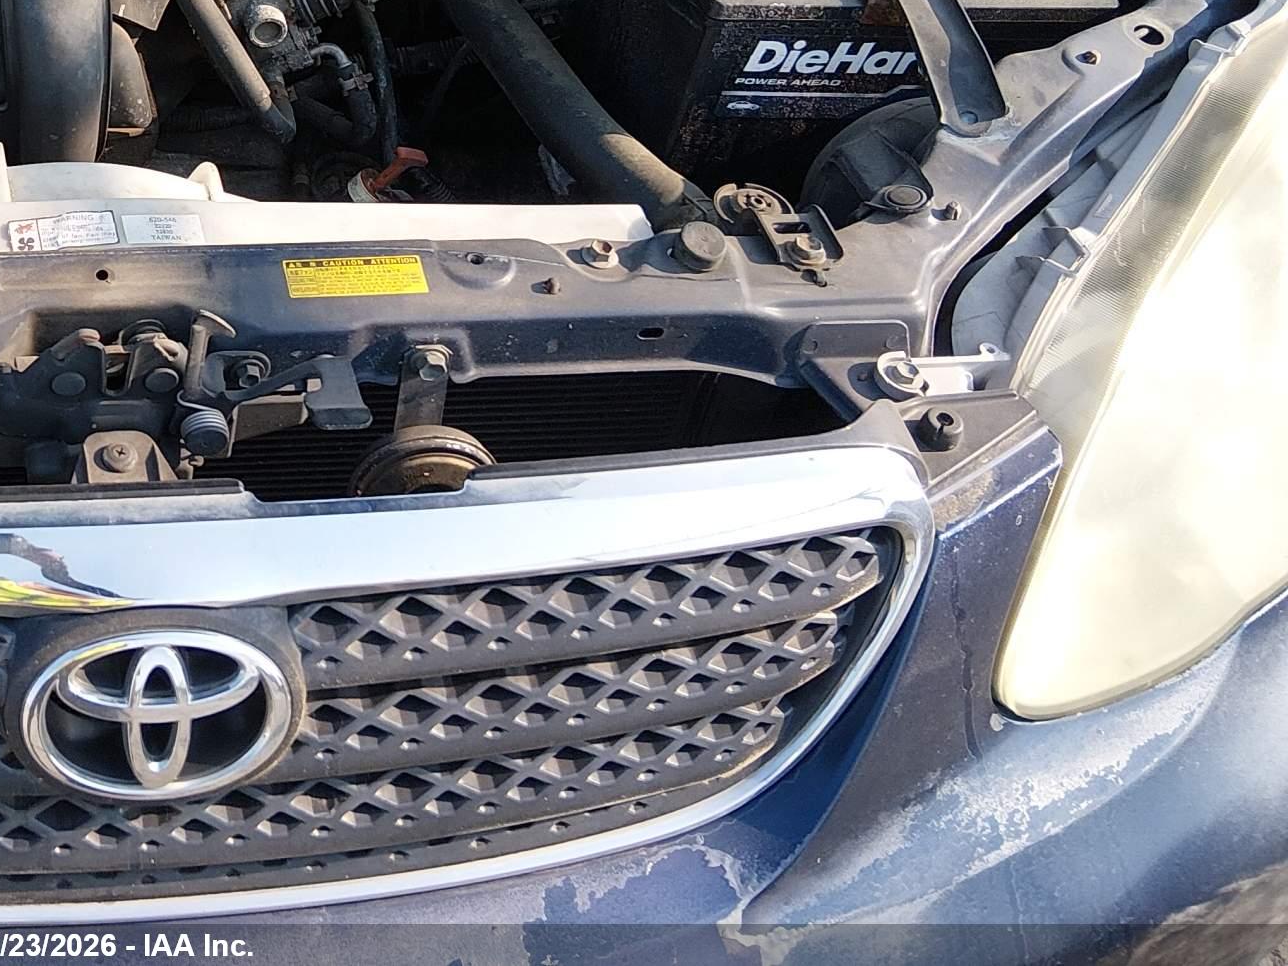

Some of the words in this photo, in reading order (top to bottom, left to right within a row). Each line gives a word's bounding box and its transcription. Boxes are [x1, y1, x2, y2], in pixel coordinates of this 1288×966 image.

[743, 40, 918, 75] DieHar
[734, 77, 788, 85] POWER
[790, 78, 842, 86] AHEAD
[53, 214, 94, 225] WARNING
[323, 259, 364, 267] CAUTION
[371, 257, 417, 266] ATTENTION
